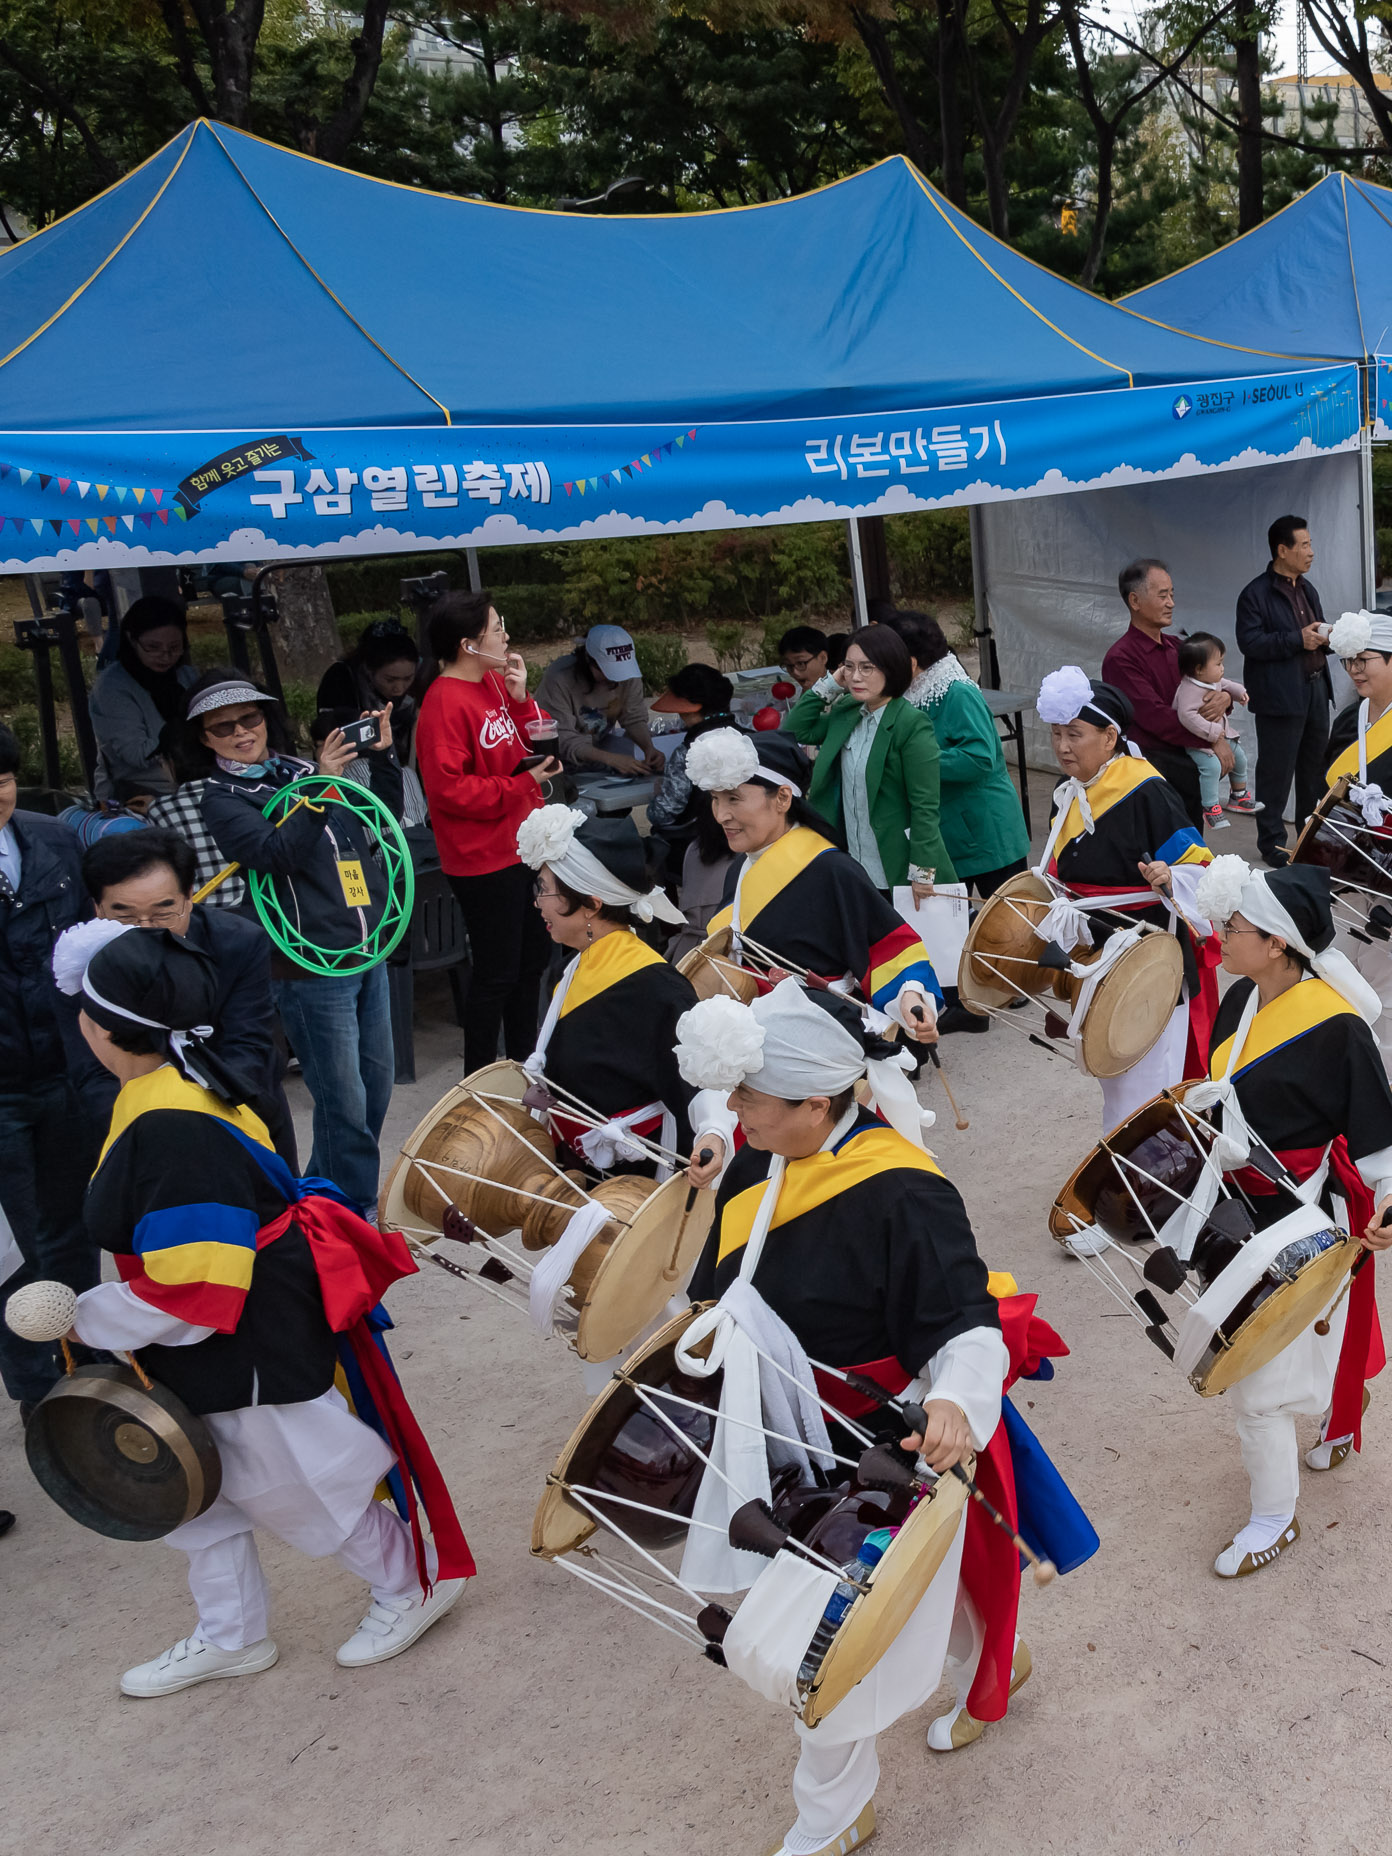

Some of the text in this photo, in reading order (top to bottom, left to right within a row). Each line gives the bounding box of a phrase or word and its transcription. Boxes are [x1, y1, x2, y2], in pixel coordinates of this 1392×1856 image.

[1196, 391, 1234, 408] 광진구
[804, 420, 1006, 480] 리본만들기
[190, 443, 282, 491] 함께 웃고 즐기는
[250, 460, 551, 519] 구삼열린축제
[344, 869, 359, 880] 마을
[349, 886, 364, 898] 강사
